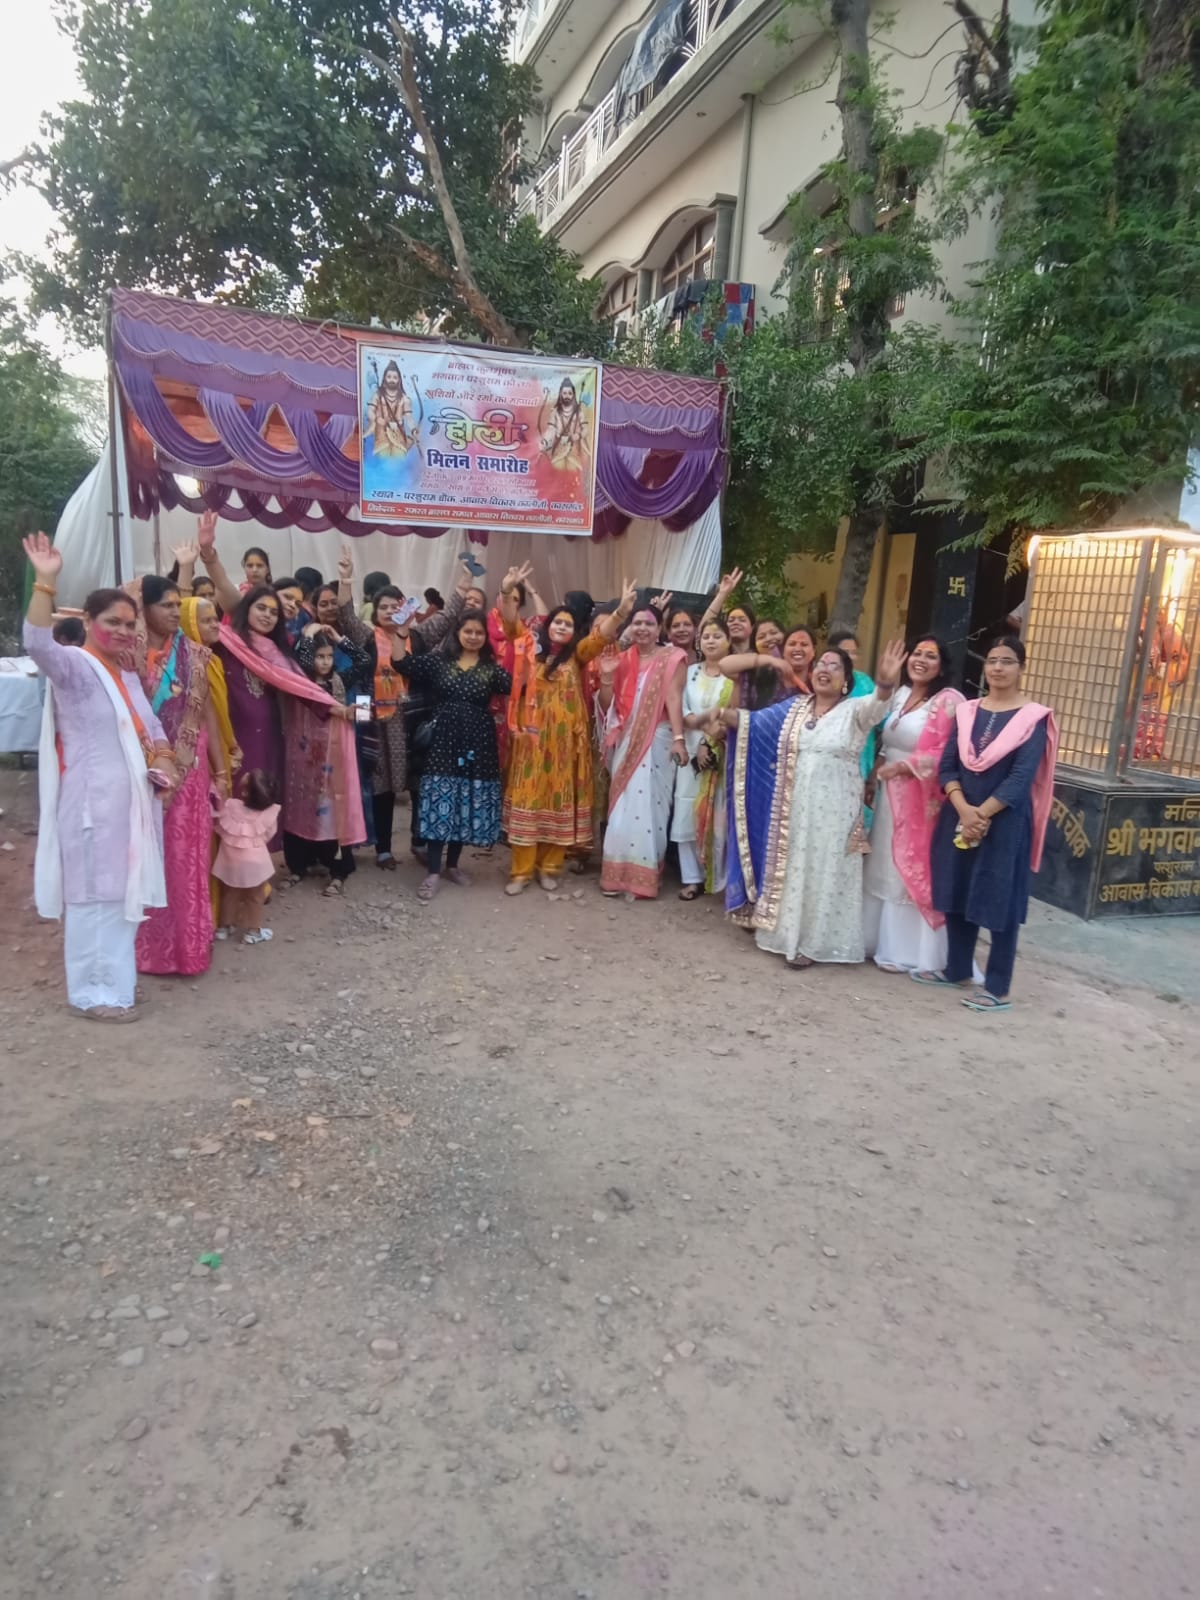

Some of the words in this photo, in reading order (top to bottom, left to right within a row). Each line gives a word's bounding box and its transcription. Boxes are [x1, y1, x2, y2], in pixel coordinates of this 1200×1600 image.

[428, 407, 528, 451] होली
[426, 449, 470, 470] मिलन
[476, 454, 529, 474] समारोह
[1106, 820, 1134, 856] श्री
